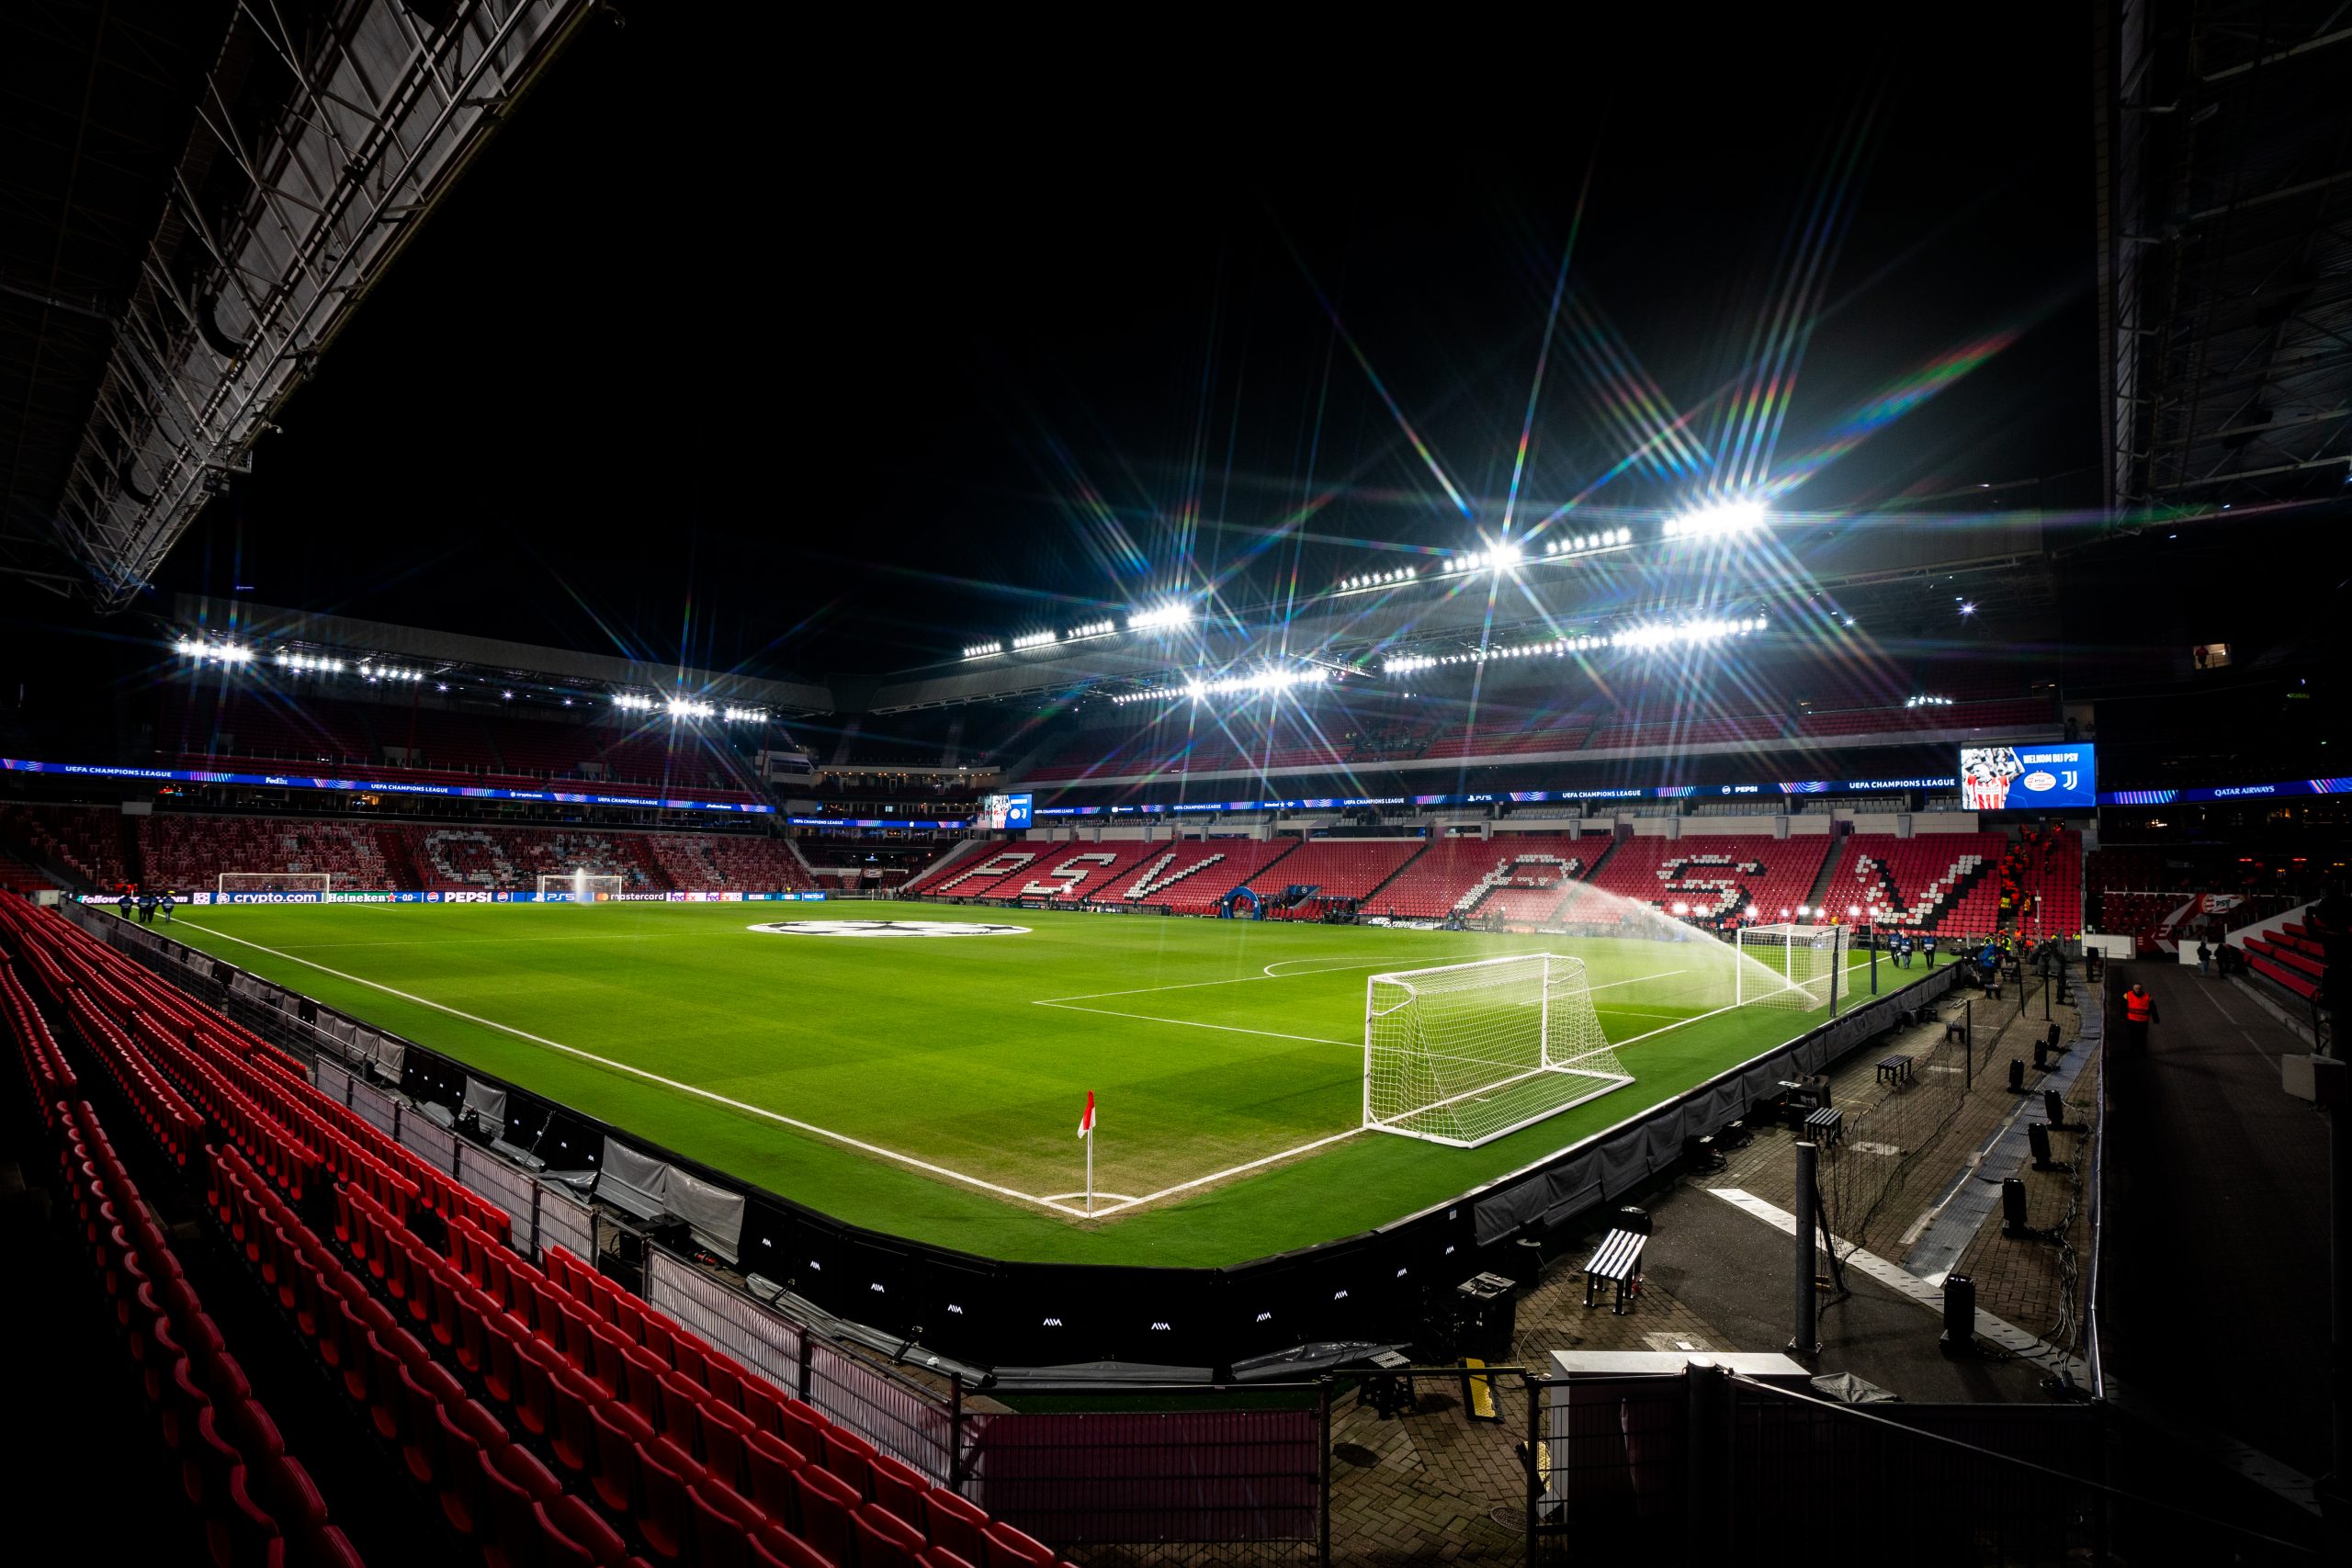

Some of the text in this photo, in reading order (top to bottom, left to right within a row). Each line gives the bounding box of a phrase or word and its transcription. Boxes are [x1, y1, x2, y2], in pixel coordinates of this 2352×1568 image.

[2023, 752, 2078, 763] WELKOM BIJ PSV
[89, 767, 140, 776] CHAMPIONS
[1871, 780, 1920, 788] CHAMPIONS
[2214, 786, 2275, 796] QATAR AIRWAYS
[939, 852, 1226, 899] PSV
[234, 894, 316, 903] crypto.com
[328, 893, 386, 902] Heineken
[445, 892, 492, 902] PEPSI
[671, 892, 695, 901] FedEx
[706, 892, 729, 901] FedEx
